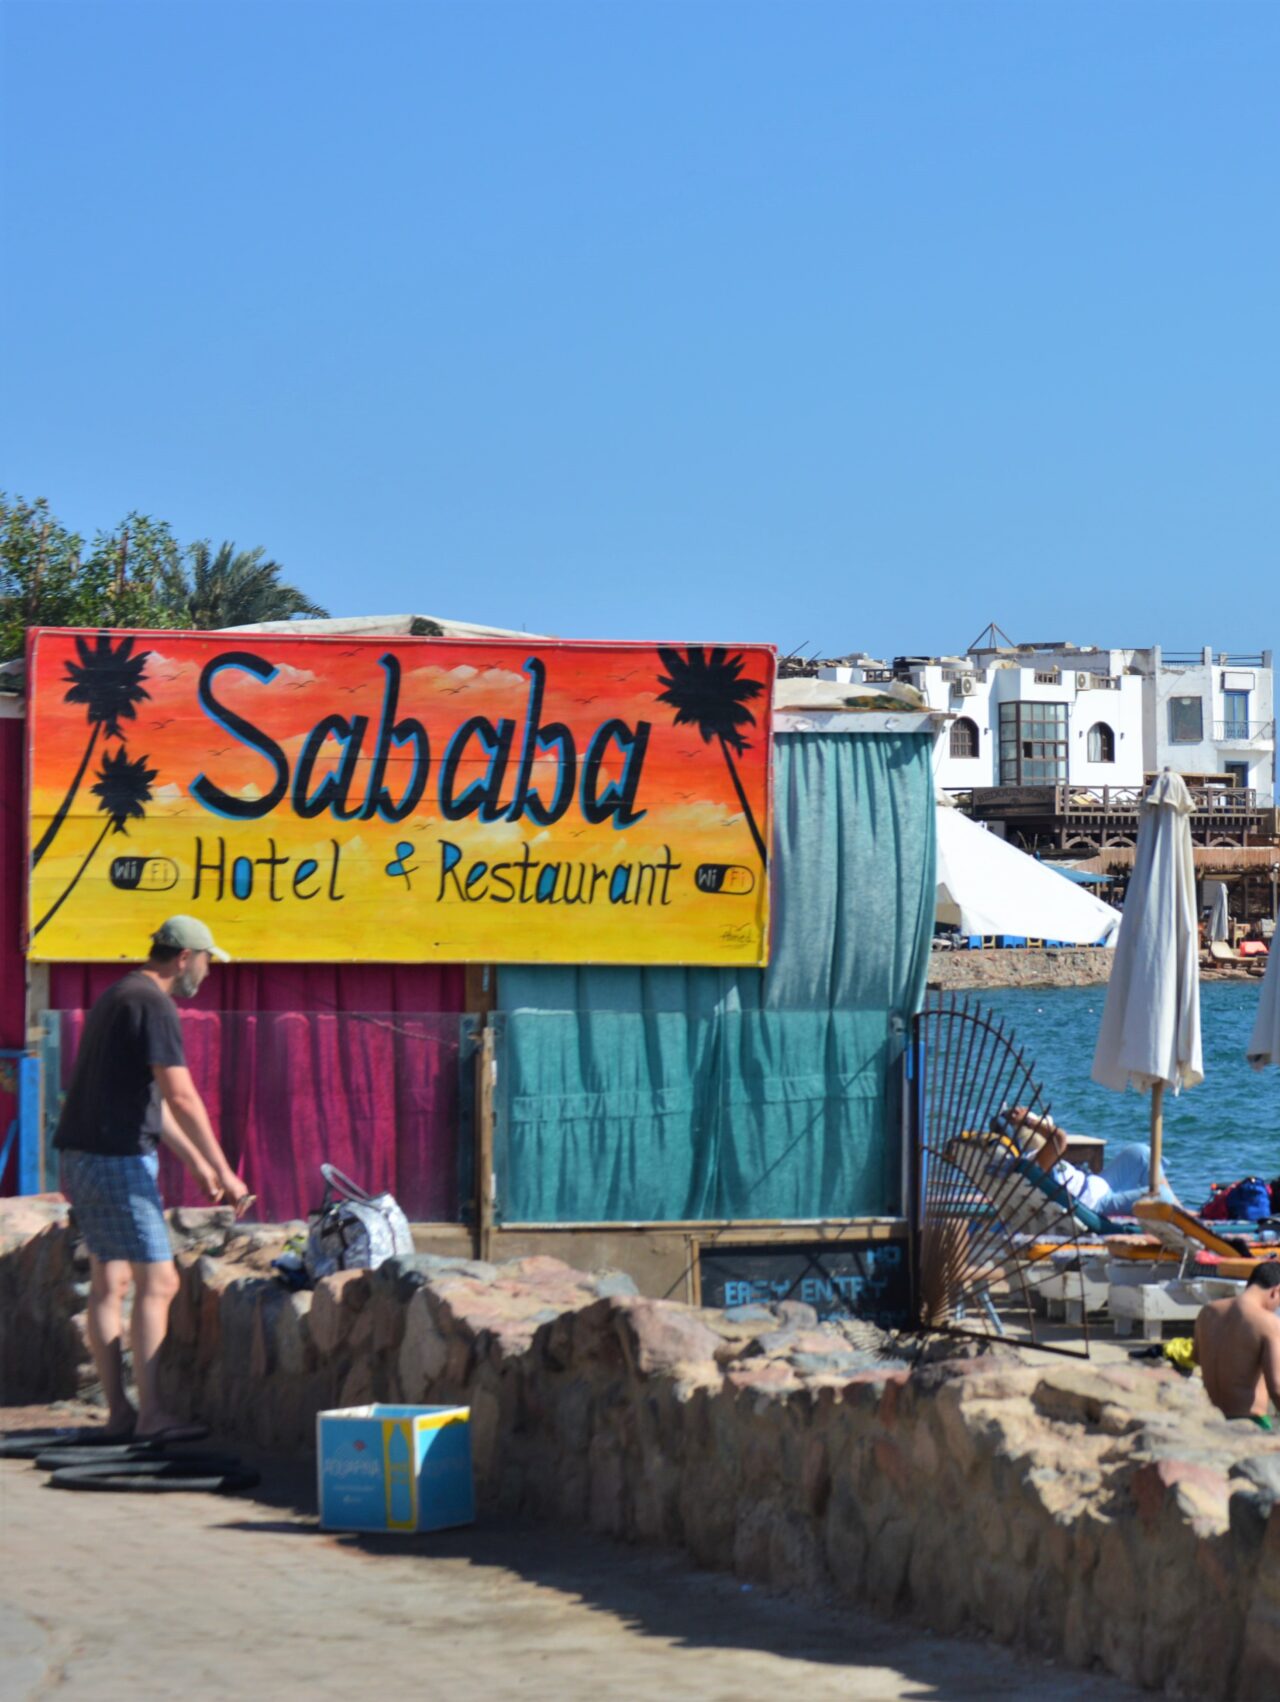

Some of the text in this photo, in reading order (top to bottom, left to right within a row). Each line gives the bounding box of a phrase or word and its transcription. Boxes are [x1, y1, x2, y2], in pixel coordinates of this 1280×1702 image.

[188, 651, 652, 830] Sababa
[192, 836, 682, 906] Hotel & Restaurant
[725, 1276, 888, 1305] EASY ENTRY
